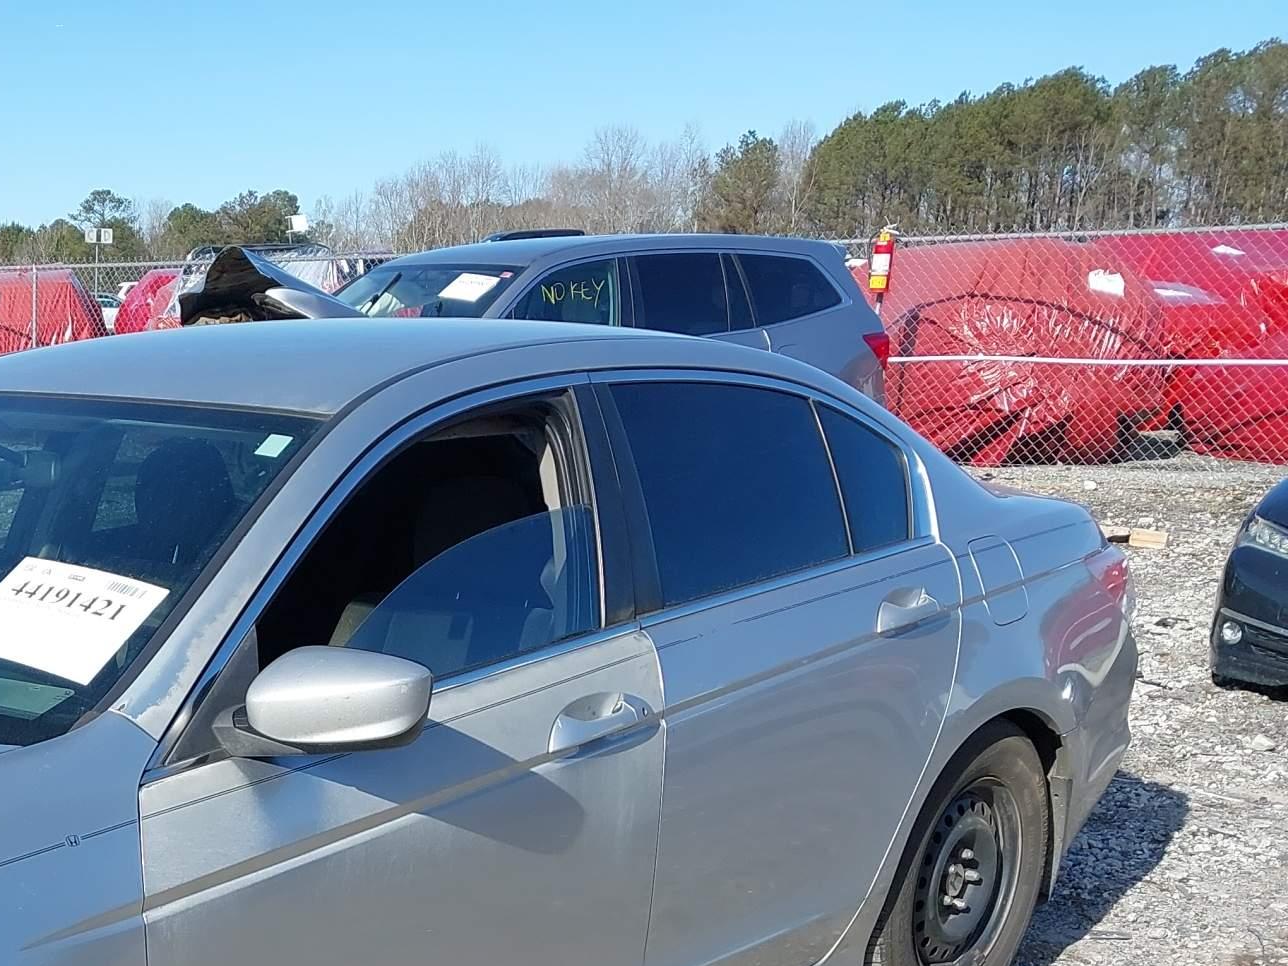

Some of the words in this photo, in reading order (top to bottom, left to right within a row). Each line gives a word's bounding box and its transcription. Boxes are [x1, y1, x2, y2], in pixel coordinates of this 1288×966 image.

[541, 282, 566, 304] NO
[570, 278, 605, 309] KEY
[11, 580, 128, 621] 44191421
